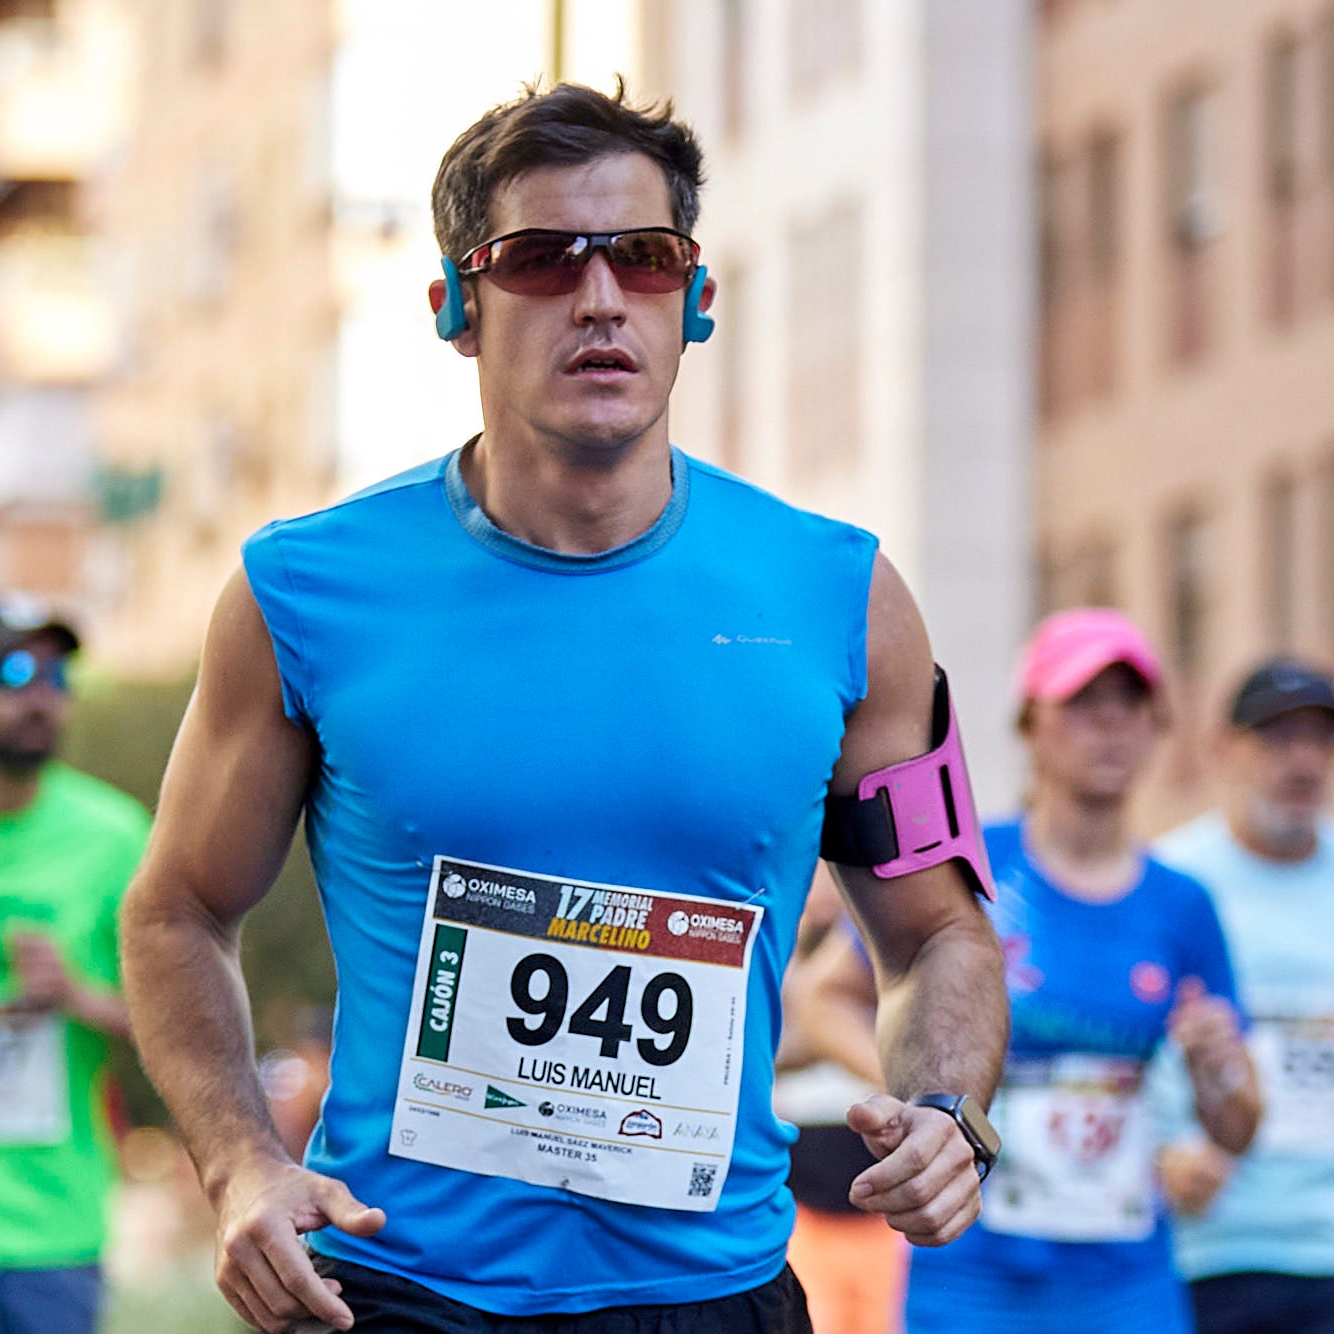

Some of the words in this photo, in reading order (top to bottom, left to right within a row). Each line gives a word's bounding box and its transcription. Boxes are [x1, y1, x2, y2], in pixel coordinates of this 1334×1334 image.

[468, 878, 536, 904] OXIMESA
[556, 885, 595, 920] 17
[591, 890, 654, 912] MEMORIAL
[589, 905, 649, 930] PADRE
[690, 914, 744, 933] OXIMESA
[547, 917, 651, 950] MARCELINO
[439, 950, 459, 966] 3
[429, 969, 456, 1032] CAJÓN
[505, 953, 694, 1067] 949
[417, 1076, 473, 1097] CALERO
[517, 1056, 567, 1085] LUIS
[570, 1066, 662, 1100] MANUEL
[557, 1103, 607, 1119] OXIMESA
[531, 1131, 565, 1144] MANUEL
[537, 1143, 582, 1160] MASTER
[585, 1152, 598, 1162] 35
